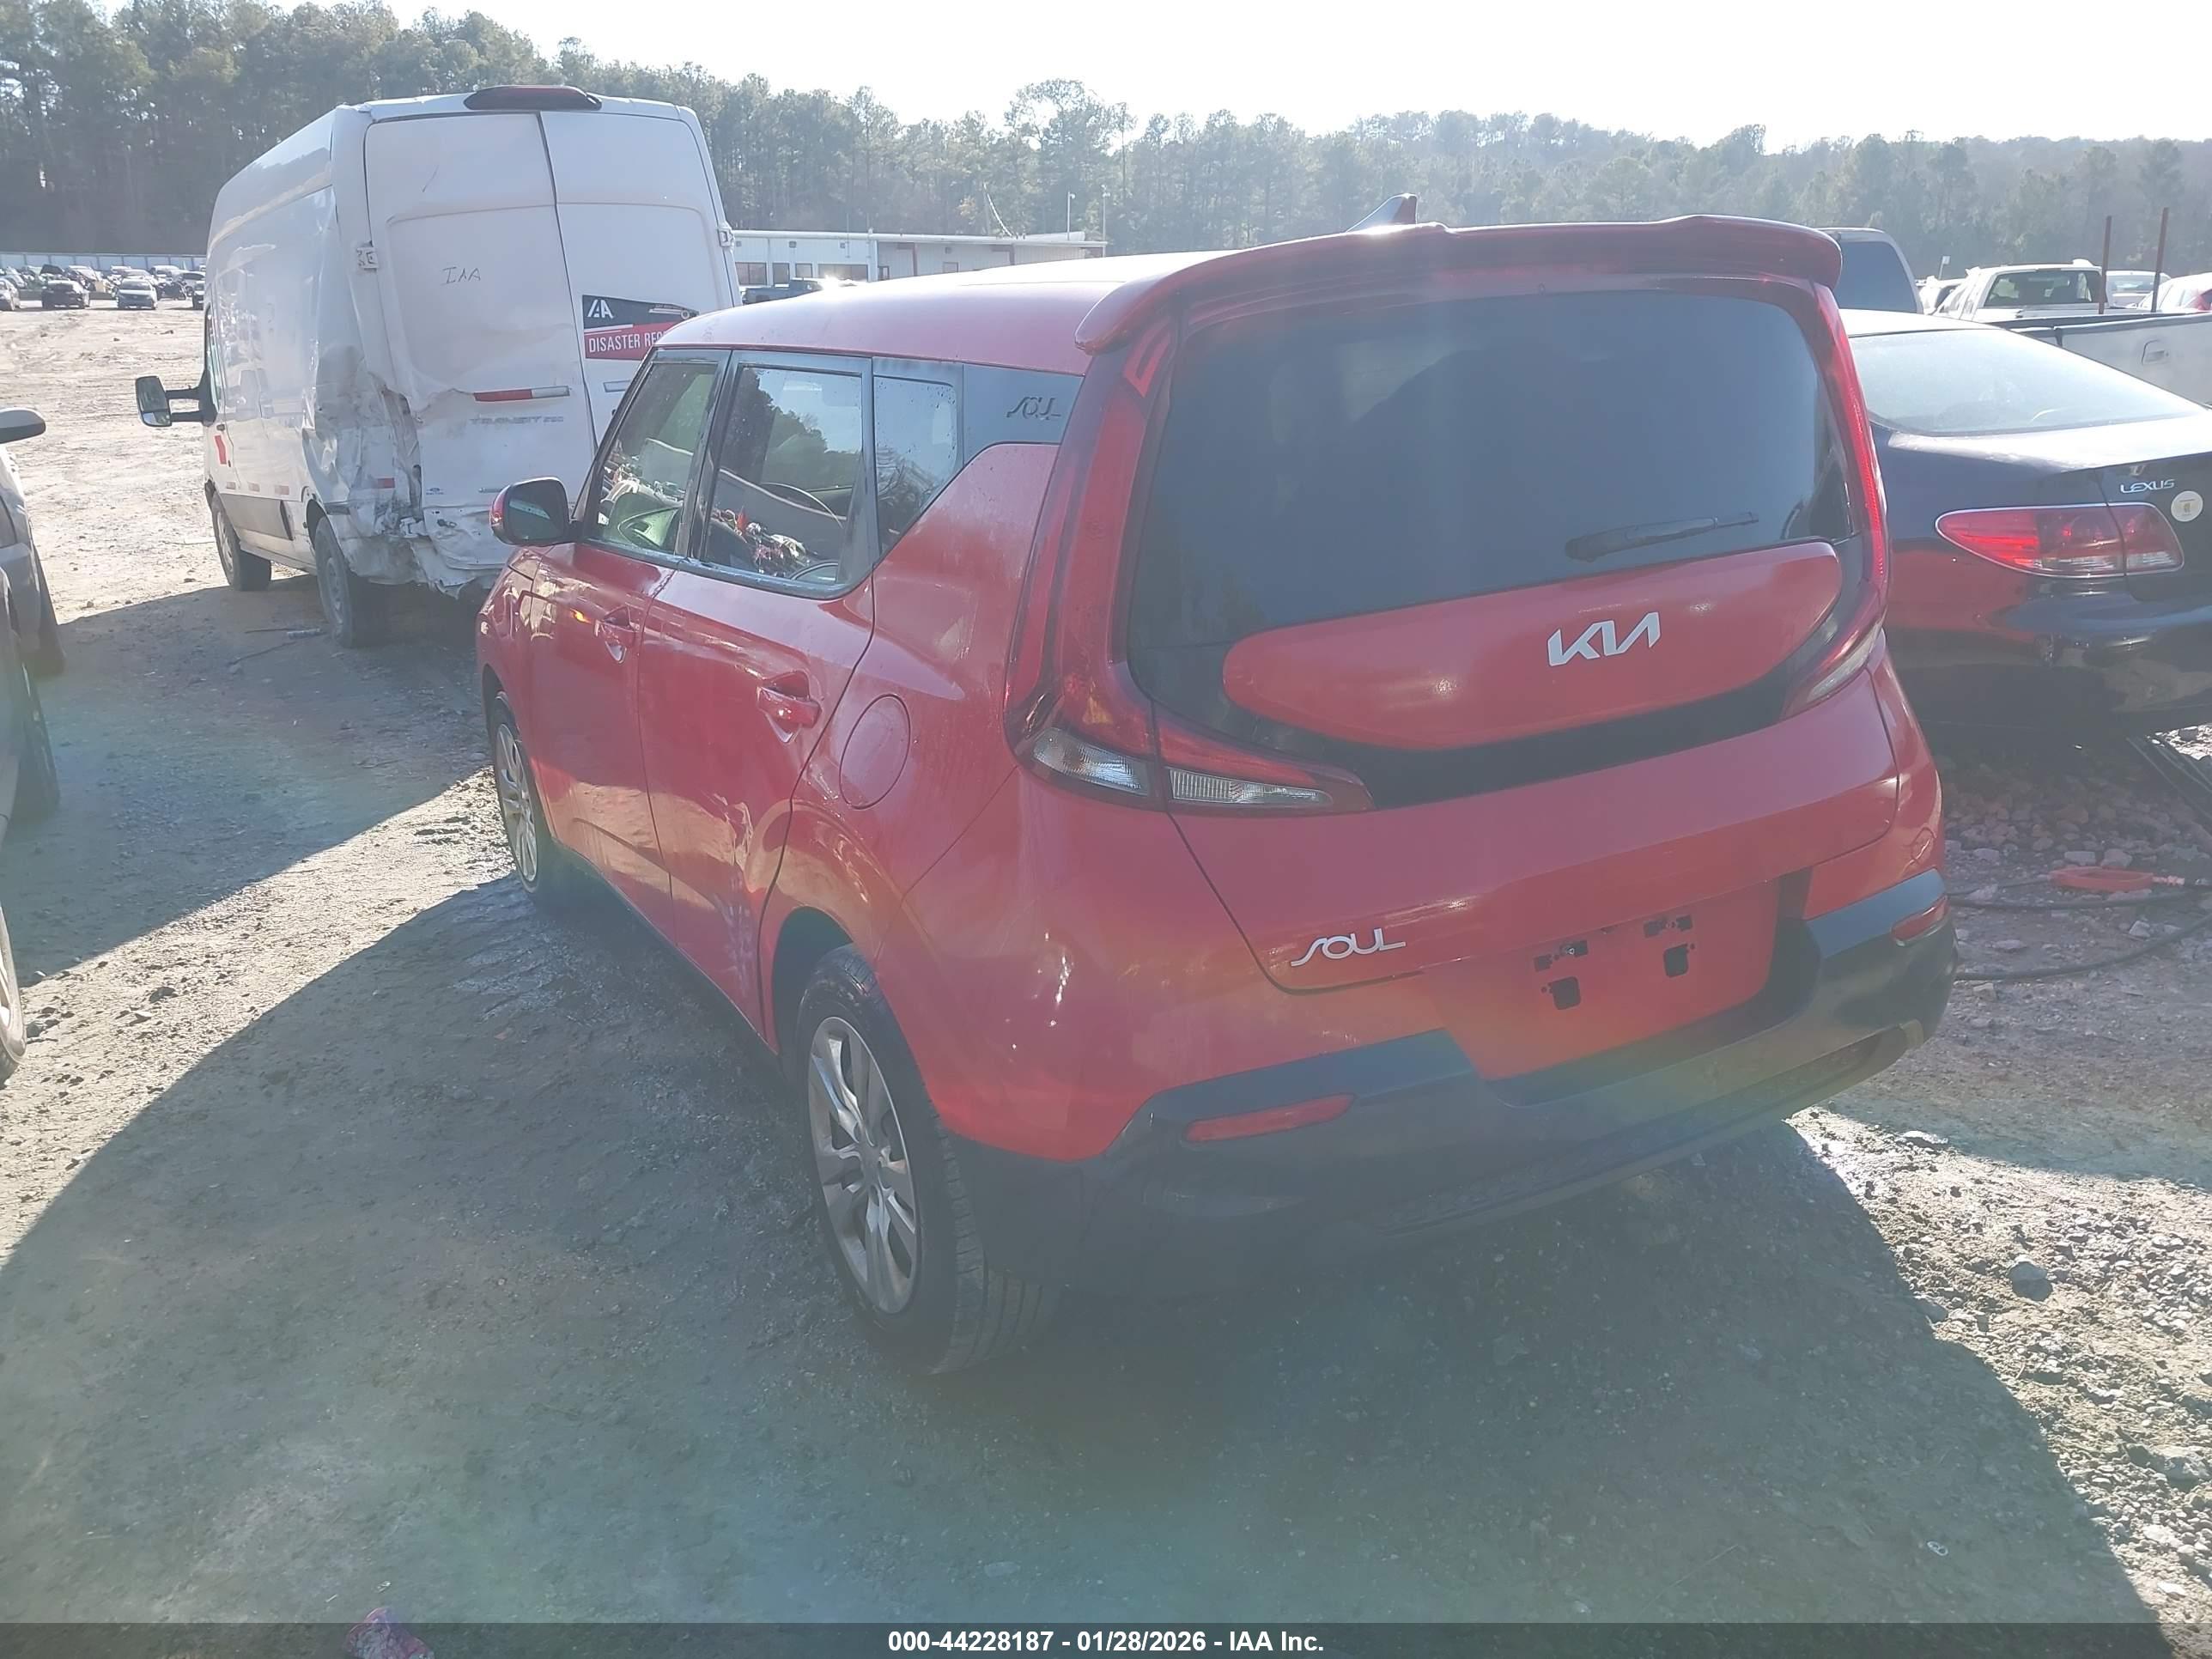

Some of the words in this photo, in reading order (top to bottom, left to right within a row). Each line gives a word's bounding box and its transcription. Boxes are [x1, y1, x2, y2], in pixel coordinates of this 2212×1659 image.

[588, 333, 641, 353] DISASTER
[2119, 479, 2175, 494] LEXUS
[1547, 611, 1662, 667] KIA
[1290, 927, 1407, 968] SOUL
